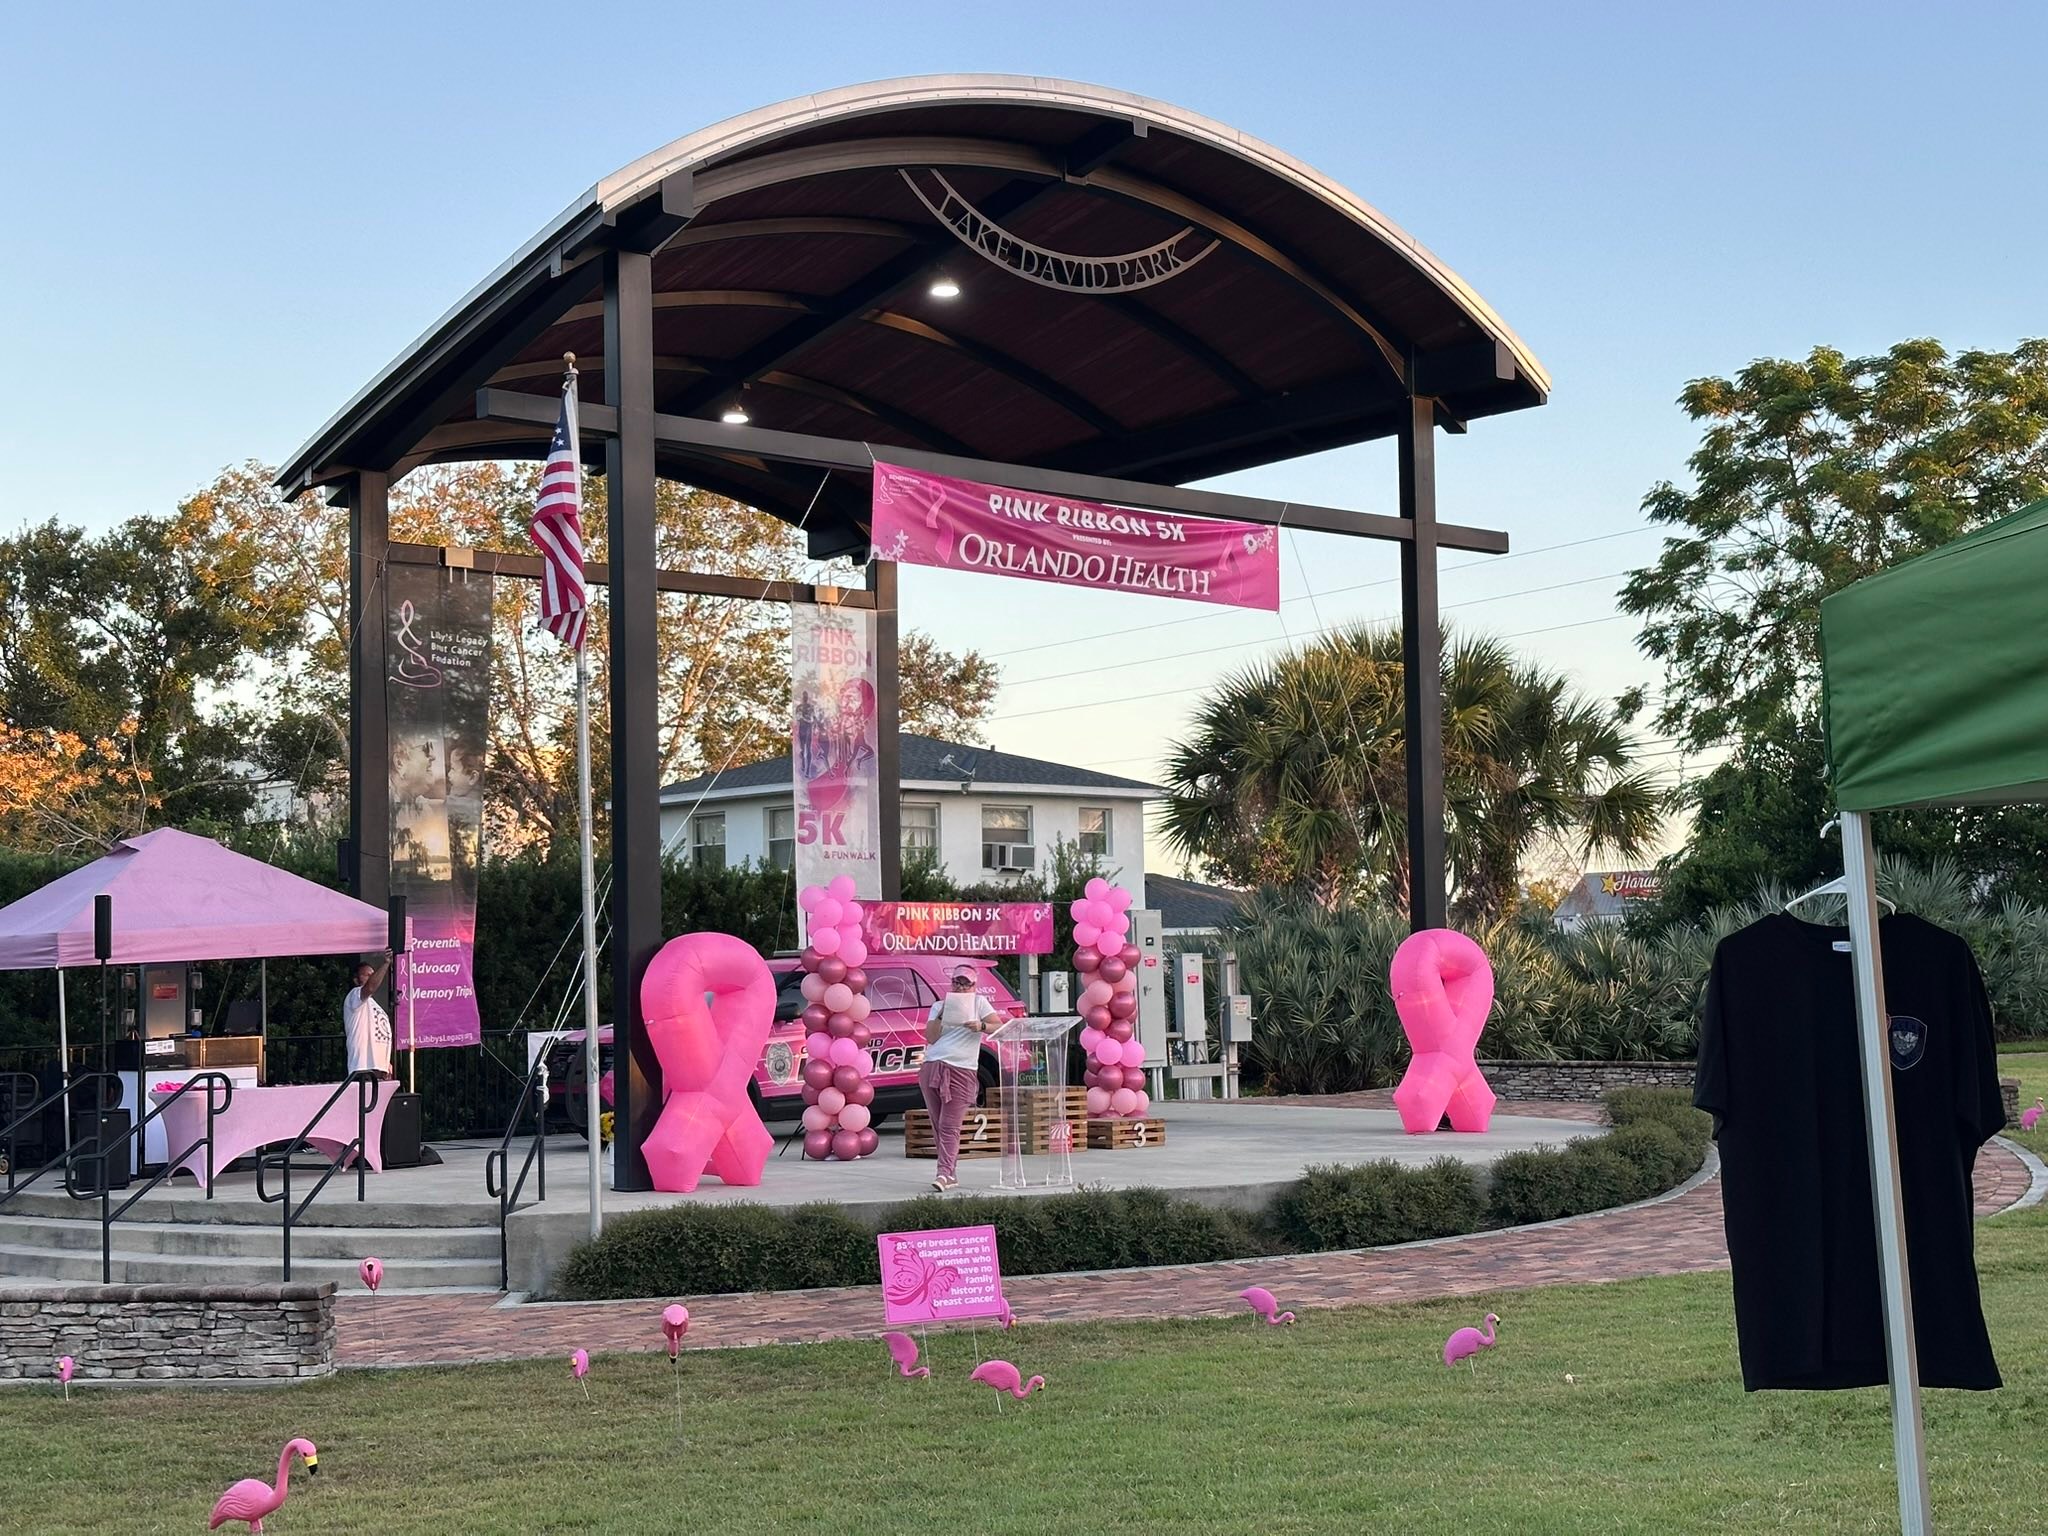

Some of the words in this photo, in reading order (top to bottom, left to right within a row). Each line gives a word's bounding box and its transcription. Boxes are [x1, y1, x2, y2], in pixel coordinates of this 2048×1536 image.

[940, 194, 1012, 266] LAKE
[1020, 250, 1108, 289] DAVID
[1117, 243, 1187, 286] PARK
[988, 493, 1050, 523] PINK
[1057, 506, 1151, 536] RIBBON
[958, 533, 1105, 581] ORLANDO
[1107, 554, 1212, 596] HEALTH
[456, 634, 488, 648] Legacy
[811, 624, 856, 646] PINK
[451, 646, 483, 656] Cancer
[797, 645, 872, 668] RIBBON
[797, 811, 847, 846] 5K
[823, 850, 830, 859] &
[896, 906, 930, 921] PINK
[933, 907, 982, 921] RIBBON
[985, 907, 1001, 921] 5K
[882, 932, 957, 951] ORLANDO
[959, 933, 1017, 951] HEALTH
[411, 961, 461, 975] Advocacy
[411, 987, 454, 1000] Memory
[455, 985, 473, 998] Trips
[973, 1113, 988, 1141] 2
[1132, 1122, 1147, 1148] 3
[896, 1241, 915, 1250] 85%
[917, 1239, 927, 1248] of
[929, 1237, 958, 1247] breast
[960, 1236, 989, 1245] cancer
[919, 1247, 963, 1258] diagnoses
[965, 1246, 980, 1254] are
[981, 1245, 991, 1253] in
[936, 1256, 970, 1267] women
[972, 1255, 992, 1264] who
[957, 1265, 979, 1275] have
[965, 1274, 994, 1285] family
[951, 1285, 982, 1296] history
[984, 1284, 995, 1293] of
[933, 1296, 962, 1307] breast
